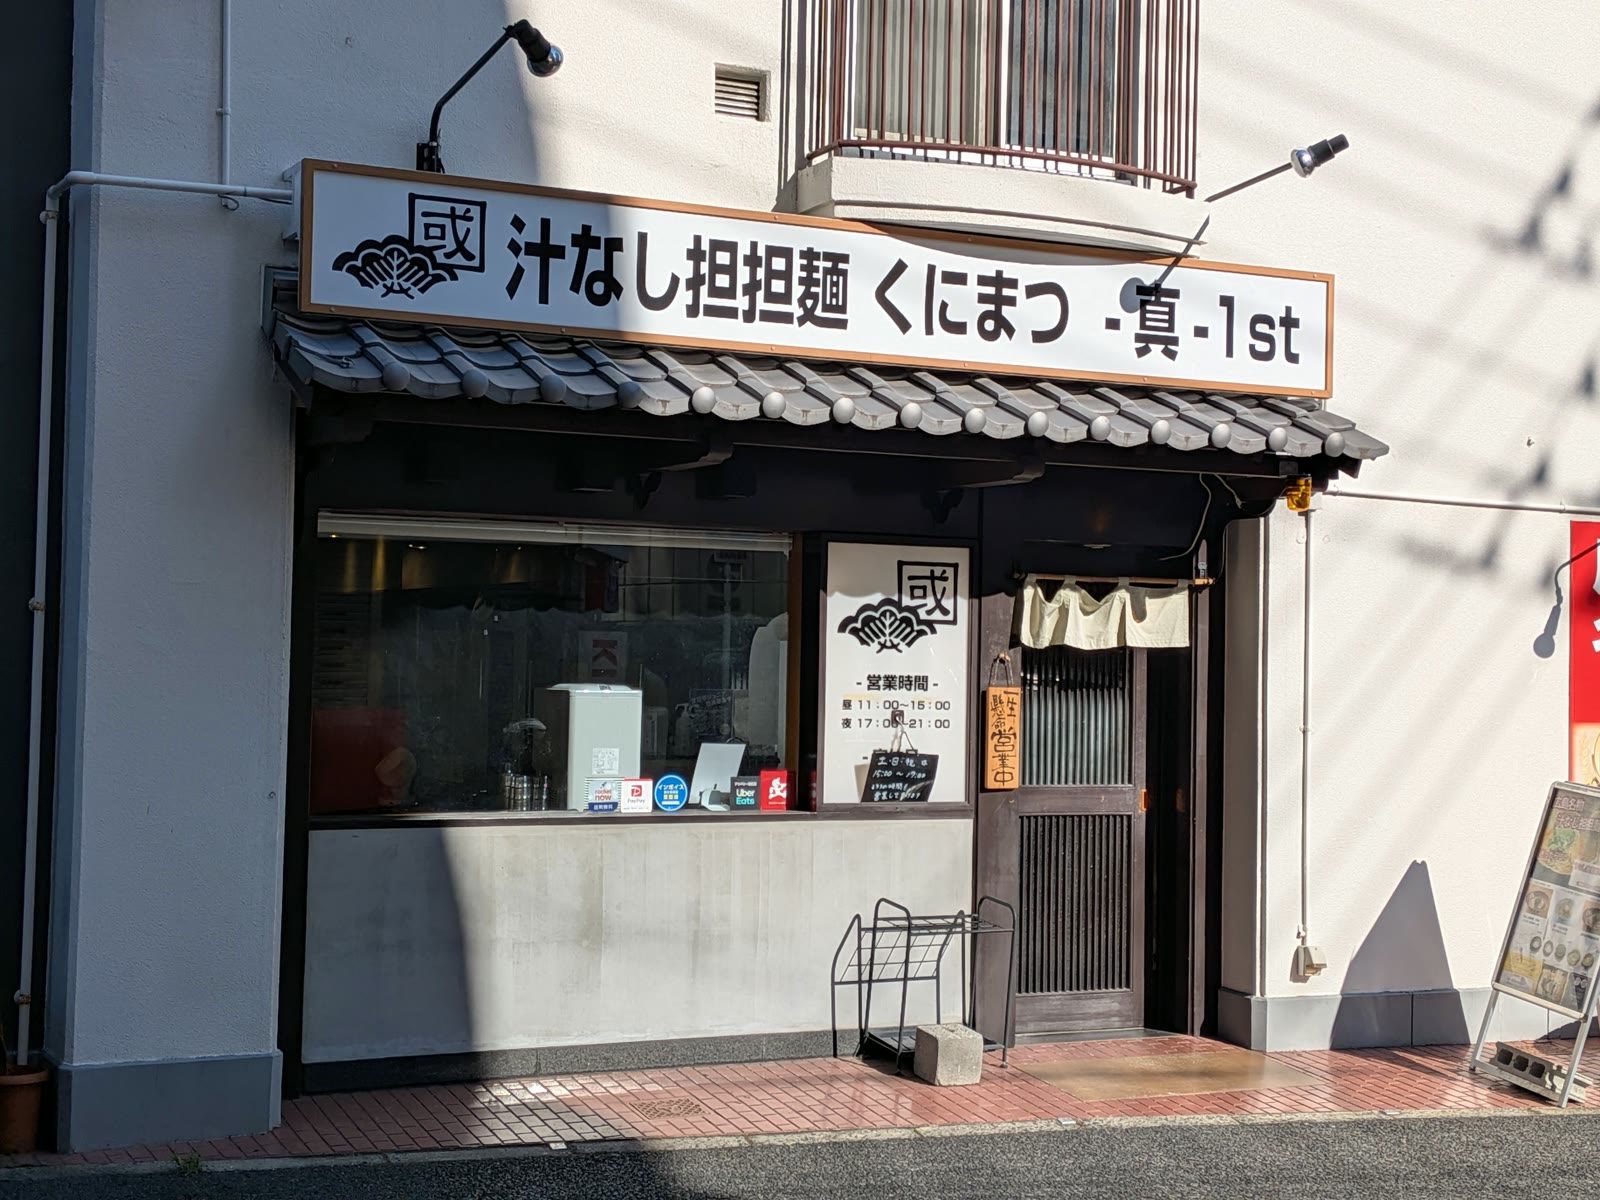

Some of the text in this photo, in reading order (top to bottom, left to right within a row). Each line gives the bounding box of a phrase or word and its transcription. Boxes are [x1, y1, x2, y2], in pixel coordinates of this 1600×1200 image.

[506, 213, 851, 330] 汁なし担担麺
[875, 257, 1069, 344] くにまつ
[842, 699, 852, 710] 昼
[842, 718, 852, 729] 夜
[990, 726, 1018, 787] 営業中
[736, 788, 755, 797] Uber
[736, 797, 755, 805] Eats
